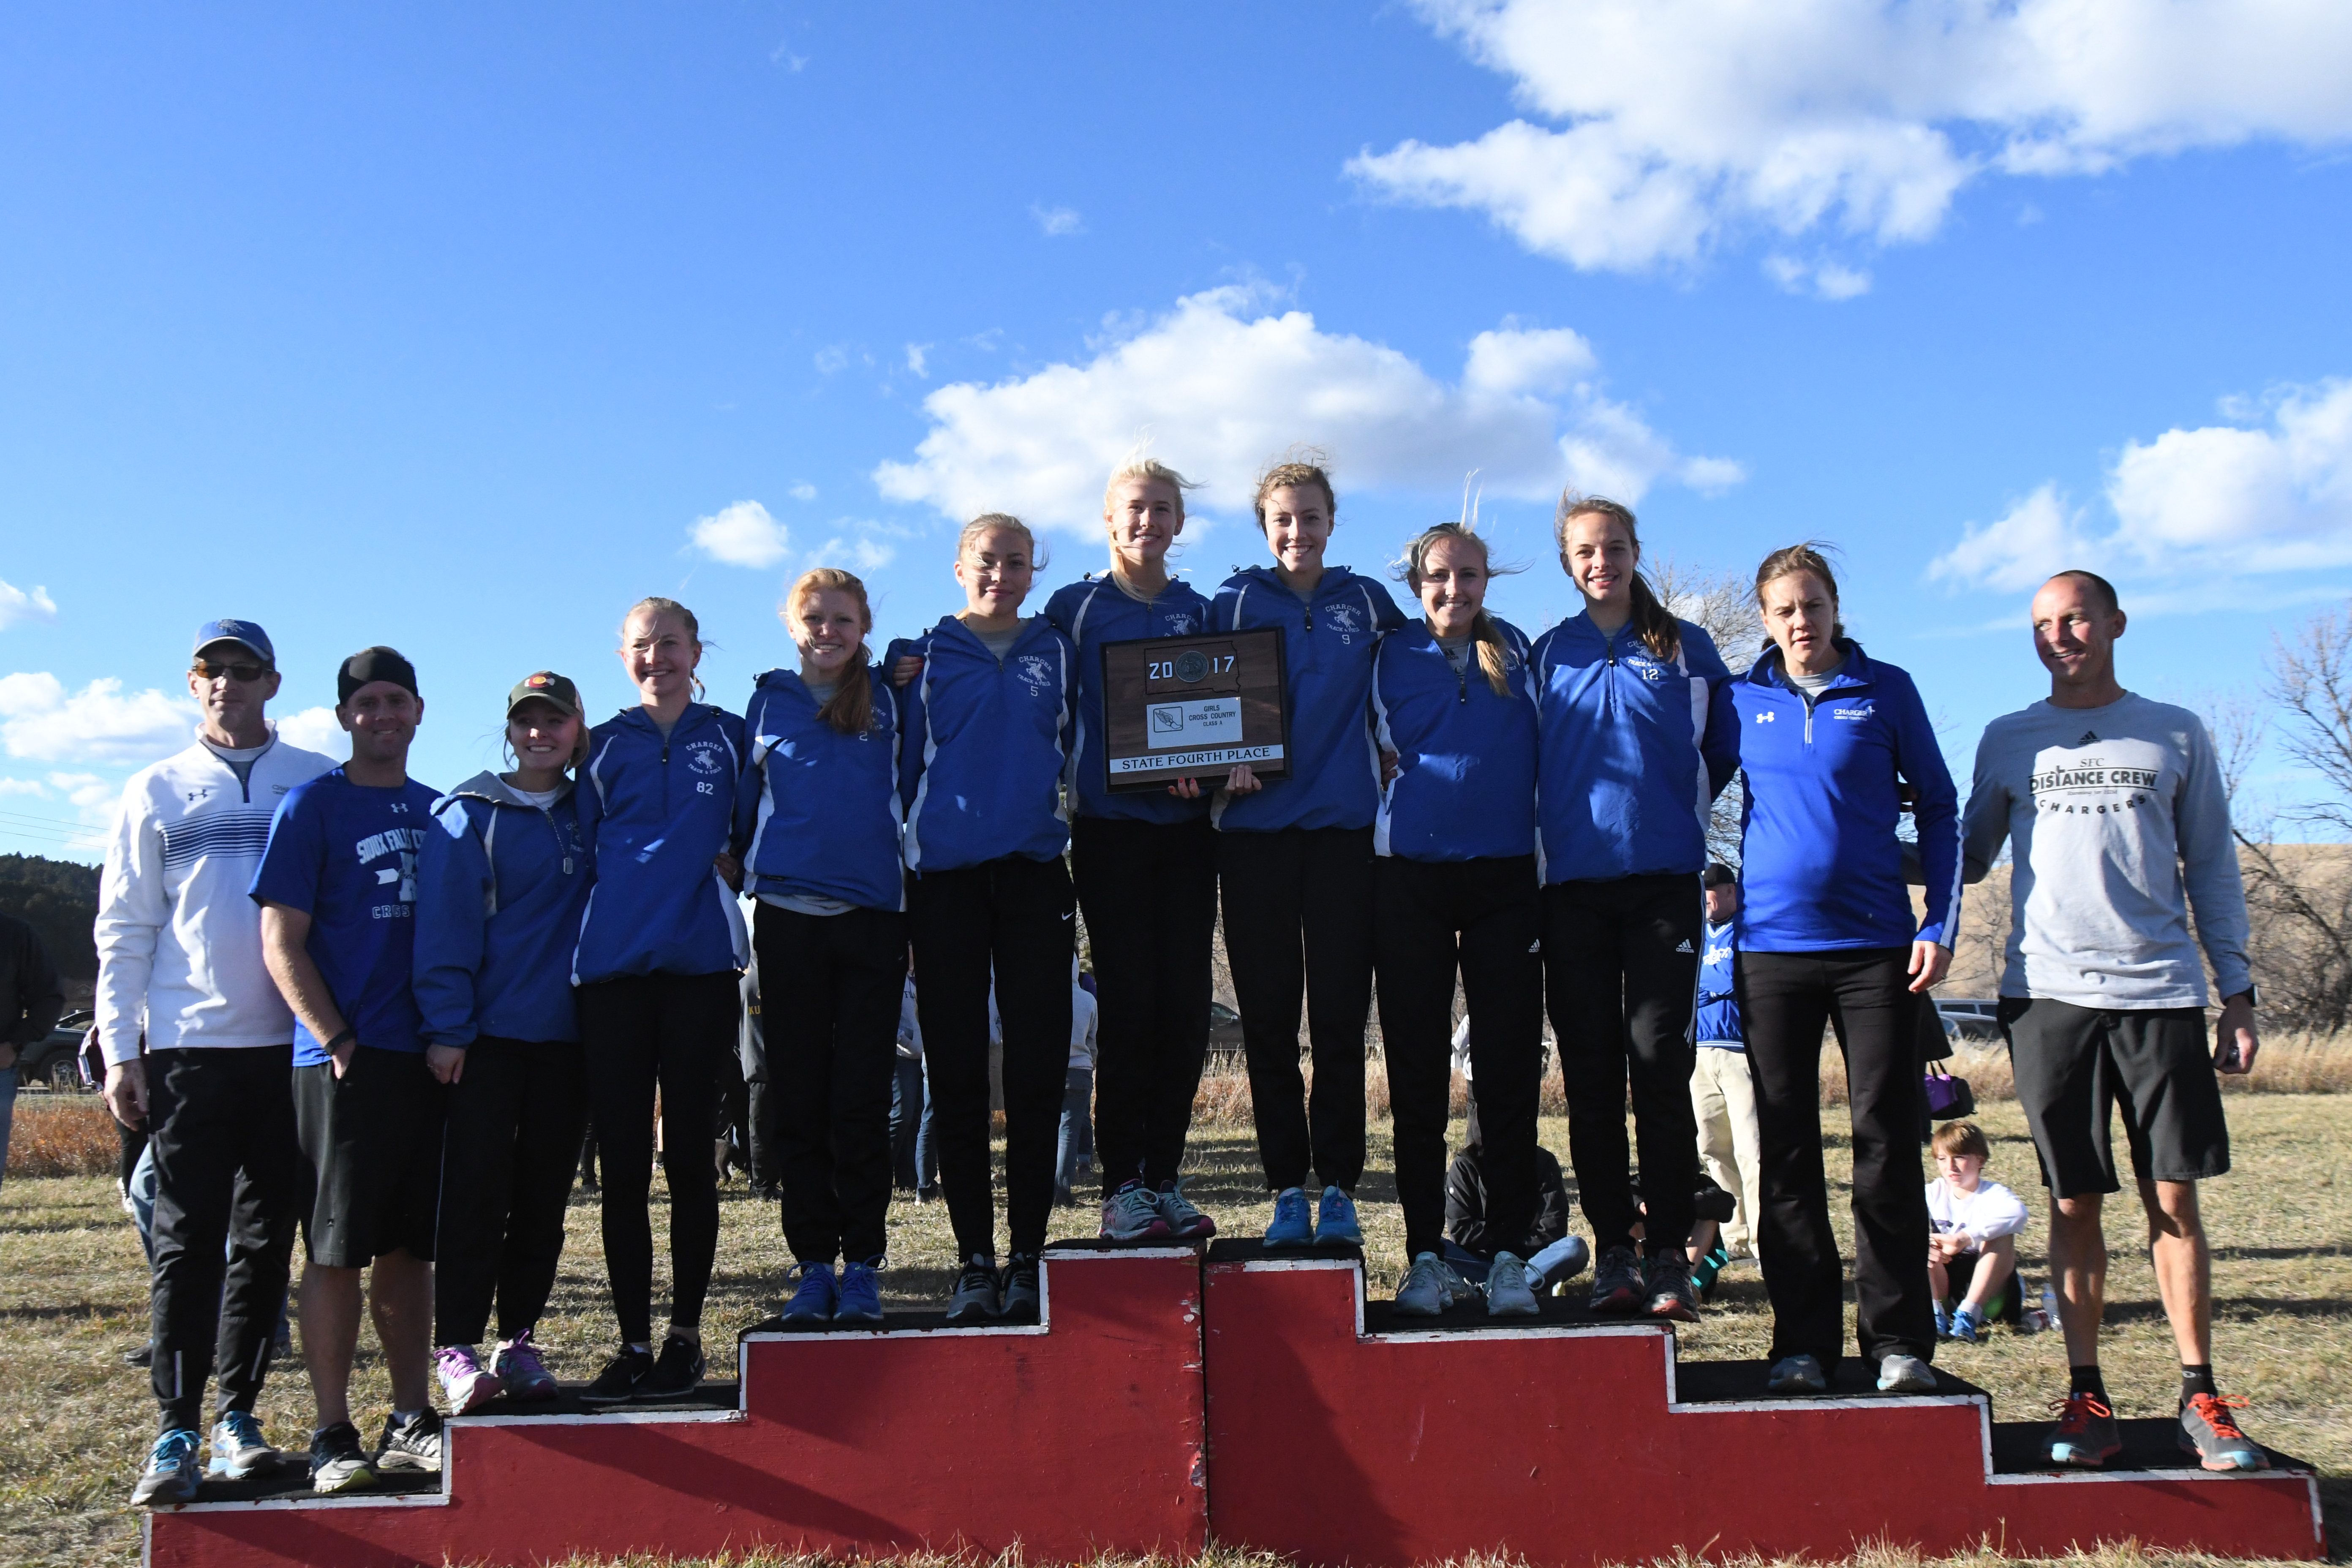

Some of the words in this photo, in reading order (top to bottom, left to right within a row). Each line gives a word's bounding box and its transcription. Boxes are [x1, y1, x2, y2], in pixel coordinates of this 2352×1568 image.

[1326, 604, 1361, 616] CHARGER
[1326, 623, 1343, 632] TRACK
[1342, 634, 1350, 644] 9
[1019, 656, 1052, 672] CHARGER
[1628, 659, 1646, 667] TRACK
[1017, 674, 1033, 684] TRACK
[1642, 669, 1658, 680] 12
[1031, 686, 1038, 697] 5
[686, 741, 724, 753] CHARGER
[1122, 757, 1163, 770] STATE
[1168, 749, 1222, 765] FOURTH
[1228, 748, 1270, 760] PLACE
[2080, 758, 2104, 767] SFC
[688, 763, 703, 773] TRACK
[2029, 765, 2104, 792] DISTANCE
[2110, 770, 2157, 787] CREW
[697, 781, 713, 795] 82
[2039, 795, 2146, 814] CHARGERS
[357, 833, 389, 865] SIOUX
